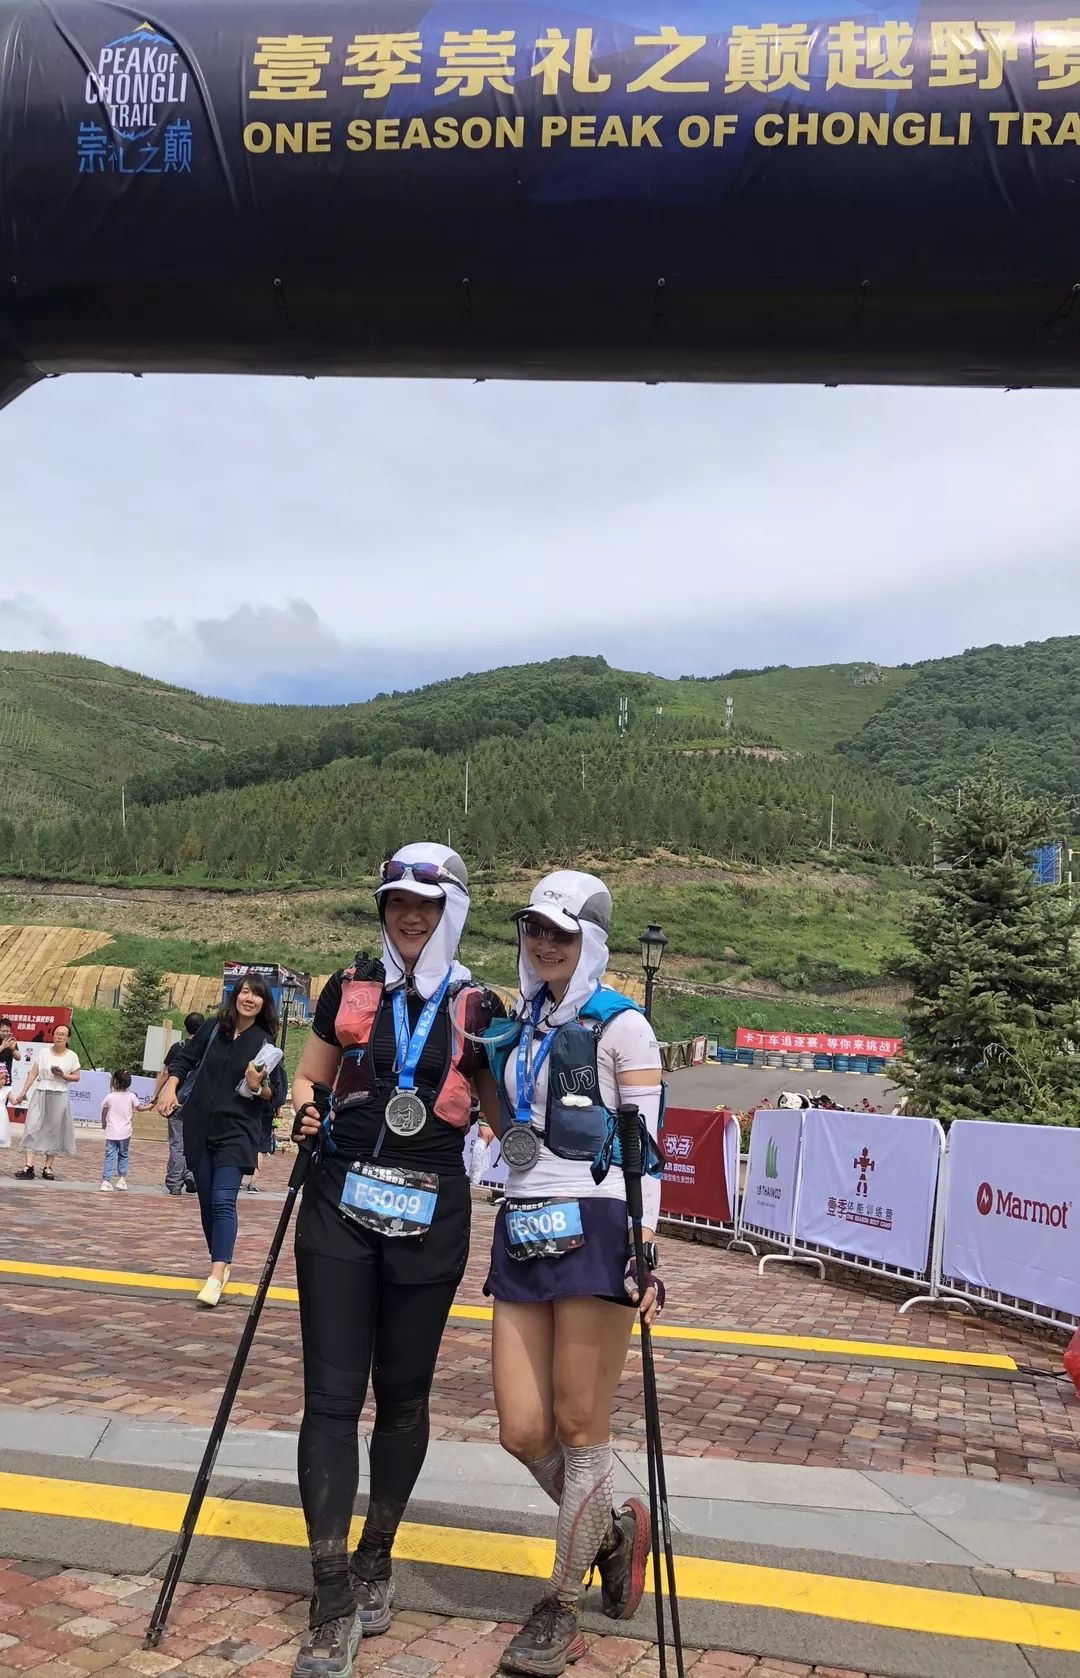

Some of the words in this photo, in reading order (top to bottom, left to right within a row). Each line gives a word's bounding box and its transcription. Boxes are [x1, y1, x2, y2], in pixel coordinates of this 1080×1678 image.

[98, 47, 158, 75] PEAK
[157, 53, 179, 73] OF
[85, 71, 188, 104] CHONGLI
[109, 103, 157, 128] TRAIL
[77, 118, 193, 174] 崇礼之巅
[243, 121, 332, 154] ONE
[346, 116, 525, 151] SEASON
[541, 114, 664, 148] PEAK
[678, 114, 739, 147] OF
[754, 111, 971, 147] CHONGLI
[989, 111, 1080, 146] TRA
[663, 1162, 673, 1173] AR
[354, 1182, 420, 1215] F5009
[995, 1189, 1069, 1230] Marmot
[509, 1210, 567, 1240] F5008
